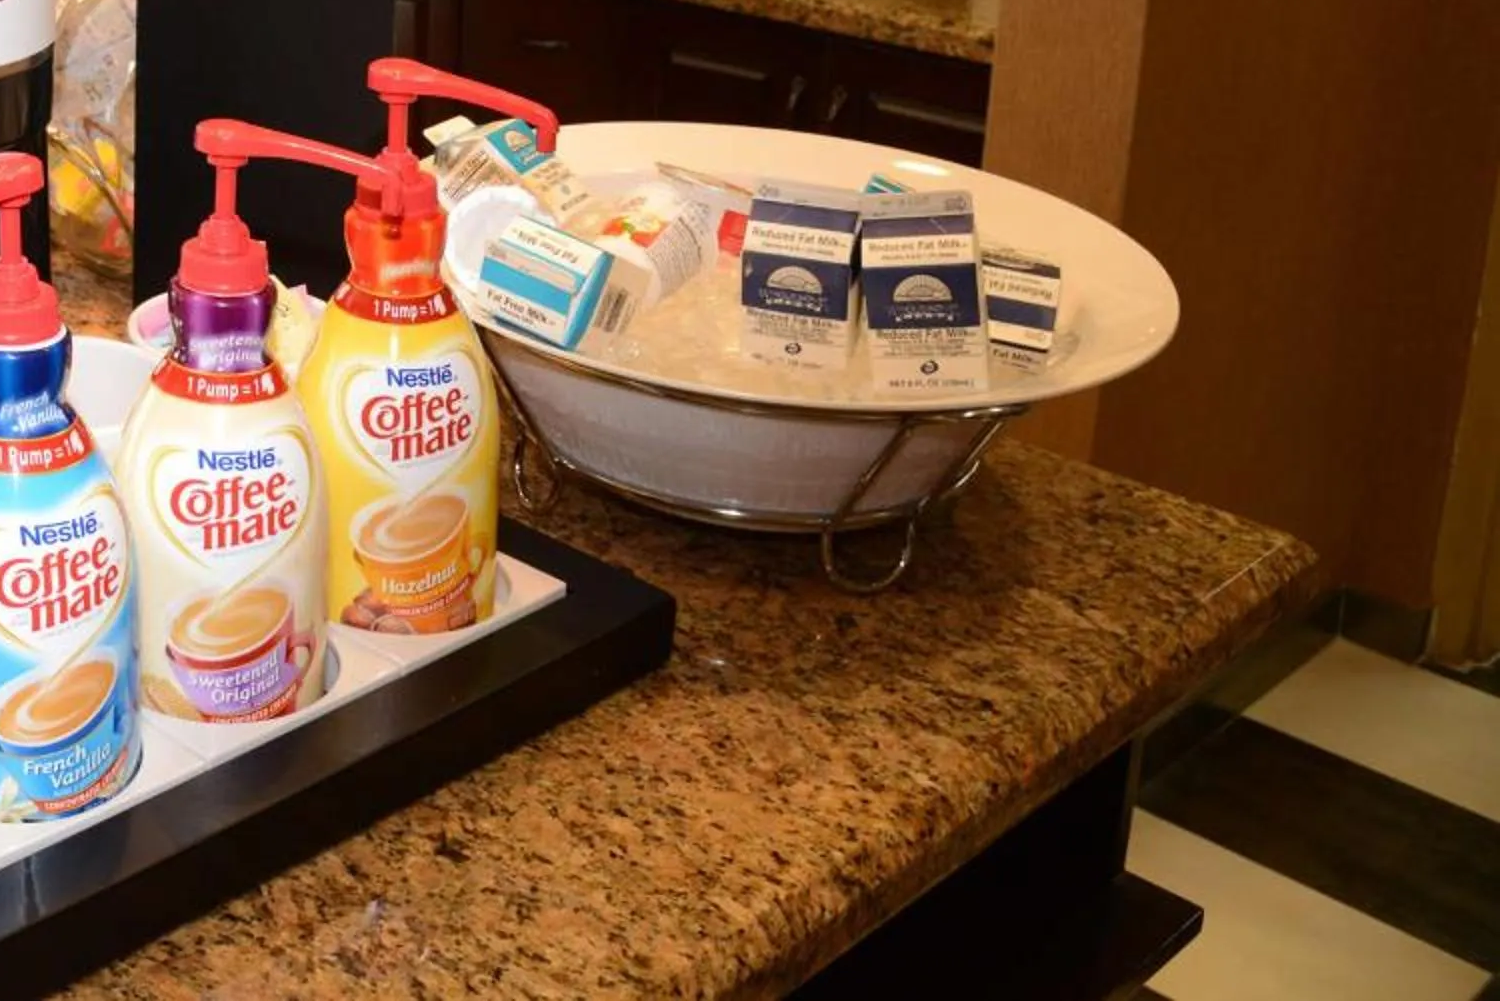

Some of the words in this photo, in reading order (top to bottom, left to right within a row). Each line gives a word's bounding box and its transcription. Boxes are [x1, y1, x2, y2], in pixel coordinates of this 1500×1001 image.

[373, 298, 380, 317] 1
[383, 299, 419, 324] Pump
[187, 376, 194, 394] 1
[196, 377, 239, 402] Pump
[386, 363, 453, 388] Nestlé
[390, 413, 472, 462] mate
[7, 445, 53, 470] Pump
[197, 446, 277, 472] Nestlé
[19, 510, 98, 547] Nestlé
[202, 499, 298, 551] mate
[381, 562, 457, 594] Hazelnut
[30, 564, 119, 632] mate
[187, 645, 278, 689] Sweetened
[211, 666, 280, 704] Original
[23, 744, 87, 776] French
[50, 742, 112, 788] Vanilla
